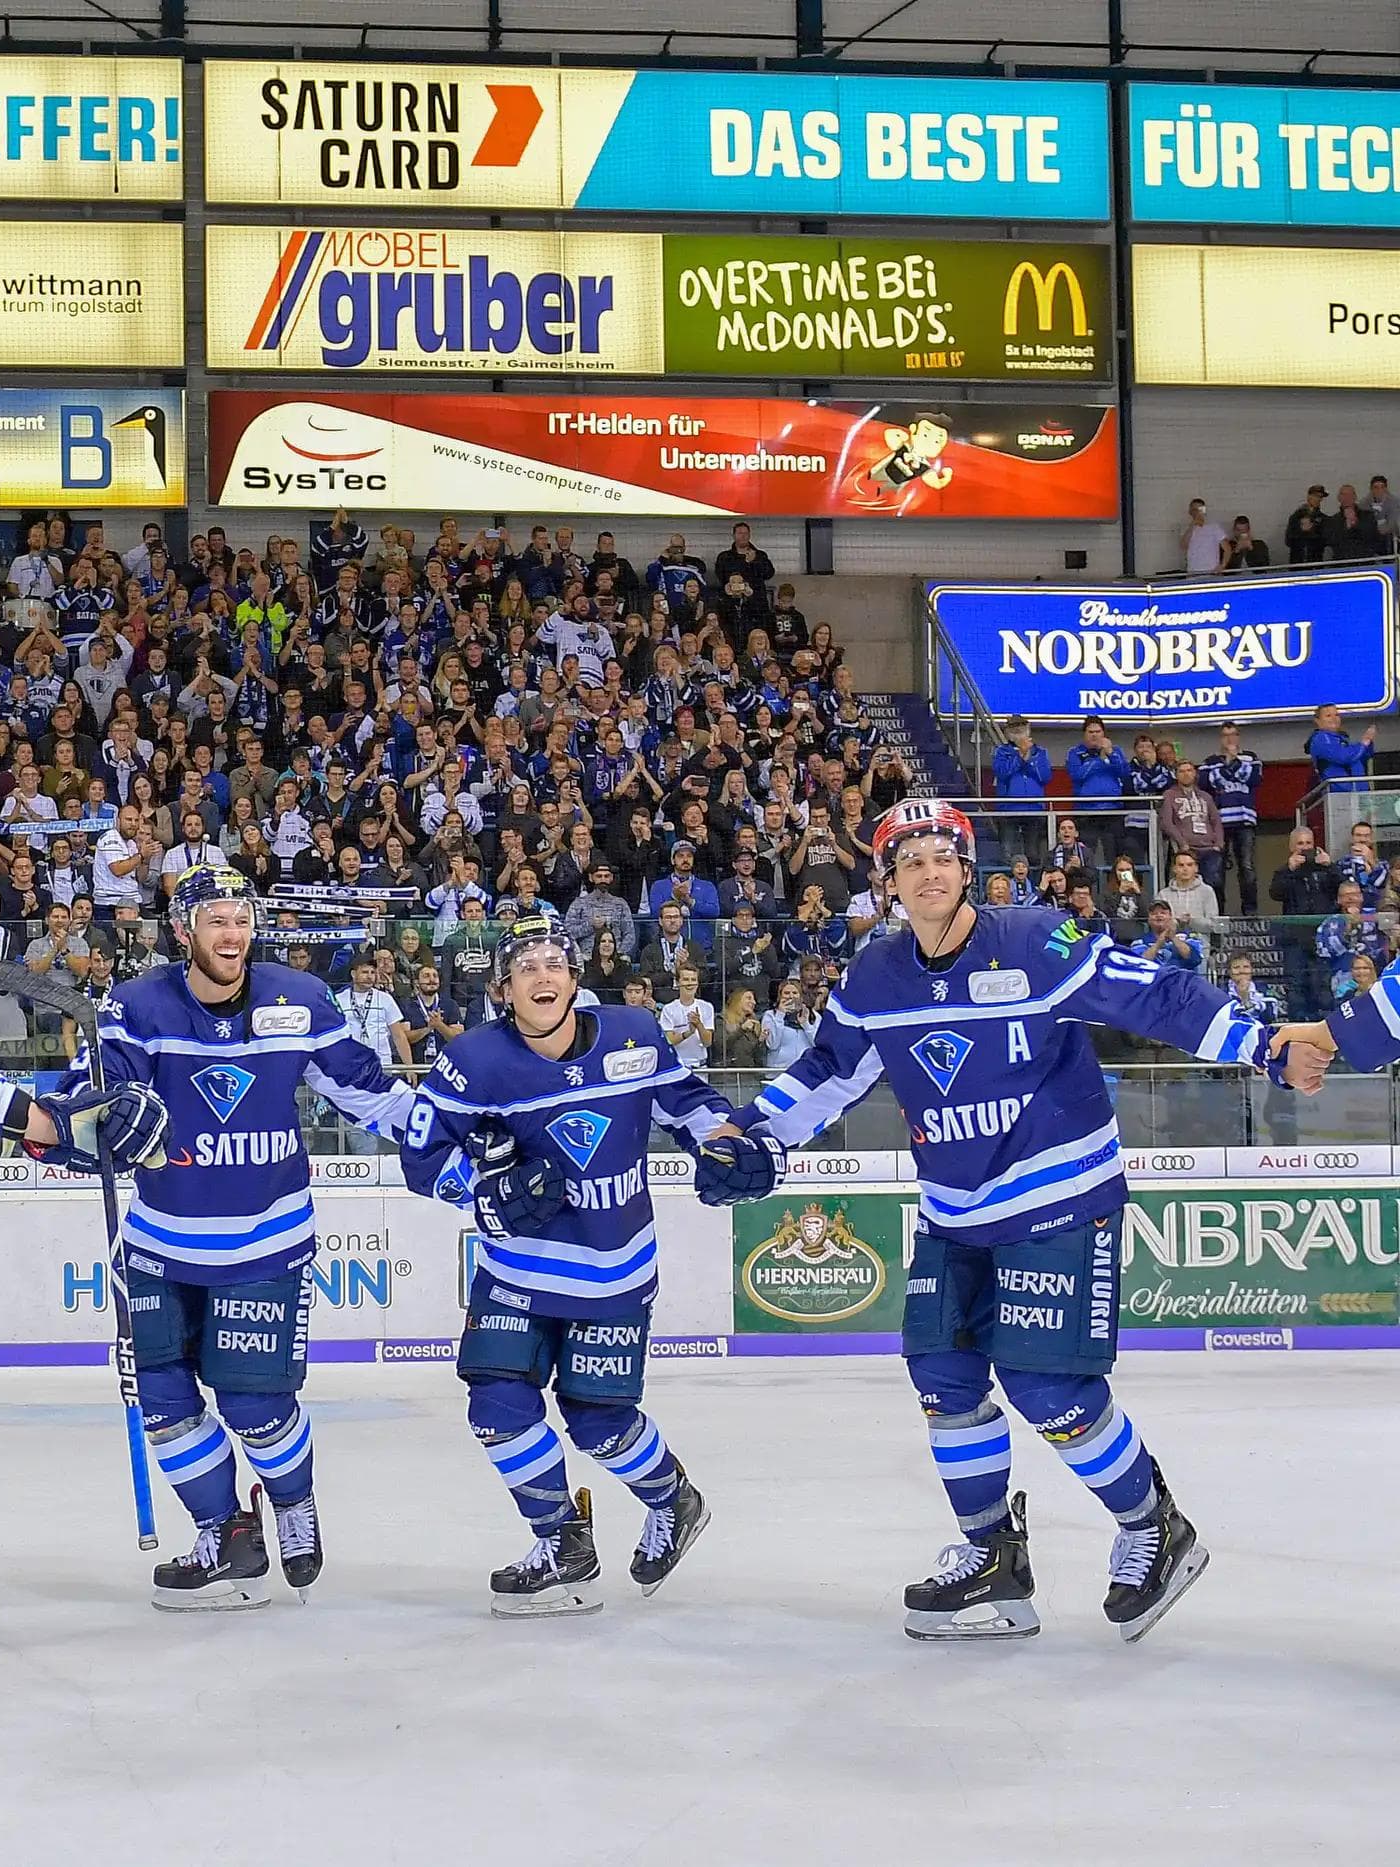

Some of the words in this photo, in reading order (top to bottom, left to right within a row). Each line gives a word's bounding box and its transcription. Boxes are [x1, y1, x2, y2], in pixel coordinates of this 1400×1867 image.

[260, 78, 460, 133] SATURN
[710, 108, 841, 180] DAS
[866, 112, 1061, 184] BESTE
[1143, 104, 1260, 189] FÜR
[320, 138, 460, 191] CARD
[329, 232, 460, 268] MÖBEL
[51, 298, 144, 316] ingolstadt
[318, 254, 614, 367] gruber
[1328, 301, 1400, 336] Pors
[377, 356, 475, 369] Siemensstr.
[479, 357, 489, 369] 7
[506, 358, 615, 370] Gaimersheim
[1022, 345, 1035, 357] in
[1036, 344, 1095, 358] Ingolstadt
[548, 412, 662, 436] IT-Helden
[667, 413, 706, 437] für
[432, 443, 623, 502] www.systec-computer.de
[660, 447, 826, 473] Unternehmen
[243, 466, 387, 495] SysTec
[1079, 600, 1231, 627] Privatbrauerei
[998, 622, 1312, 684] NORDBRÄU
[1079, 686, 1231, 709] INGOLSTADT
[1006, 1019, 1032, 1065] A
[1258, 1154, 1308, 1169] Audi
[1030, 1213, 1075, 1233] BAUER
[755, 1267, 872, 1286] HERRNBRÄU
[998, 1268, 1076, 1297] HERRN
[1090, 1231, 1113, 1340] SATURN
[212, 1297, 287, 1323] HERRN
[999, 1301, 1065, 1330] BRÄU
[479, 1315, 530, 1334] SATURN
[567, 1321, 642, 1347] HERRN
[216, 1330, 278, 1354] BRÄU
[571, 1352, 633, 1377] BRÄU
